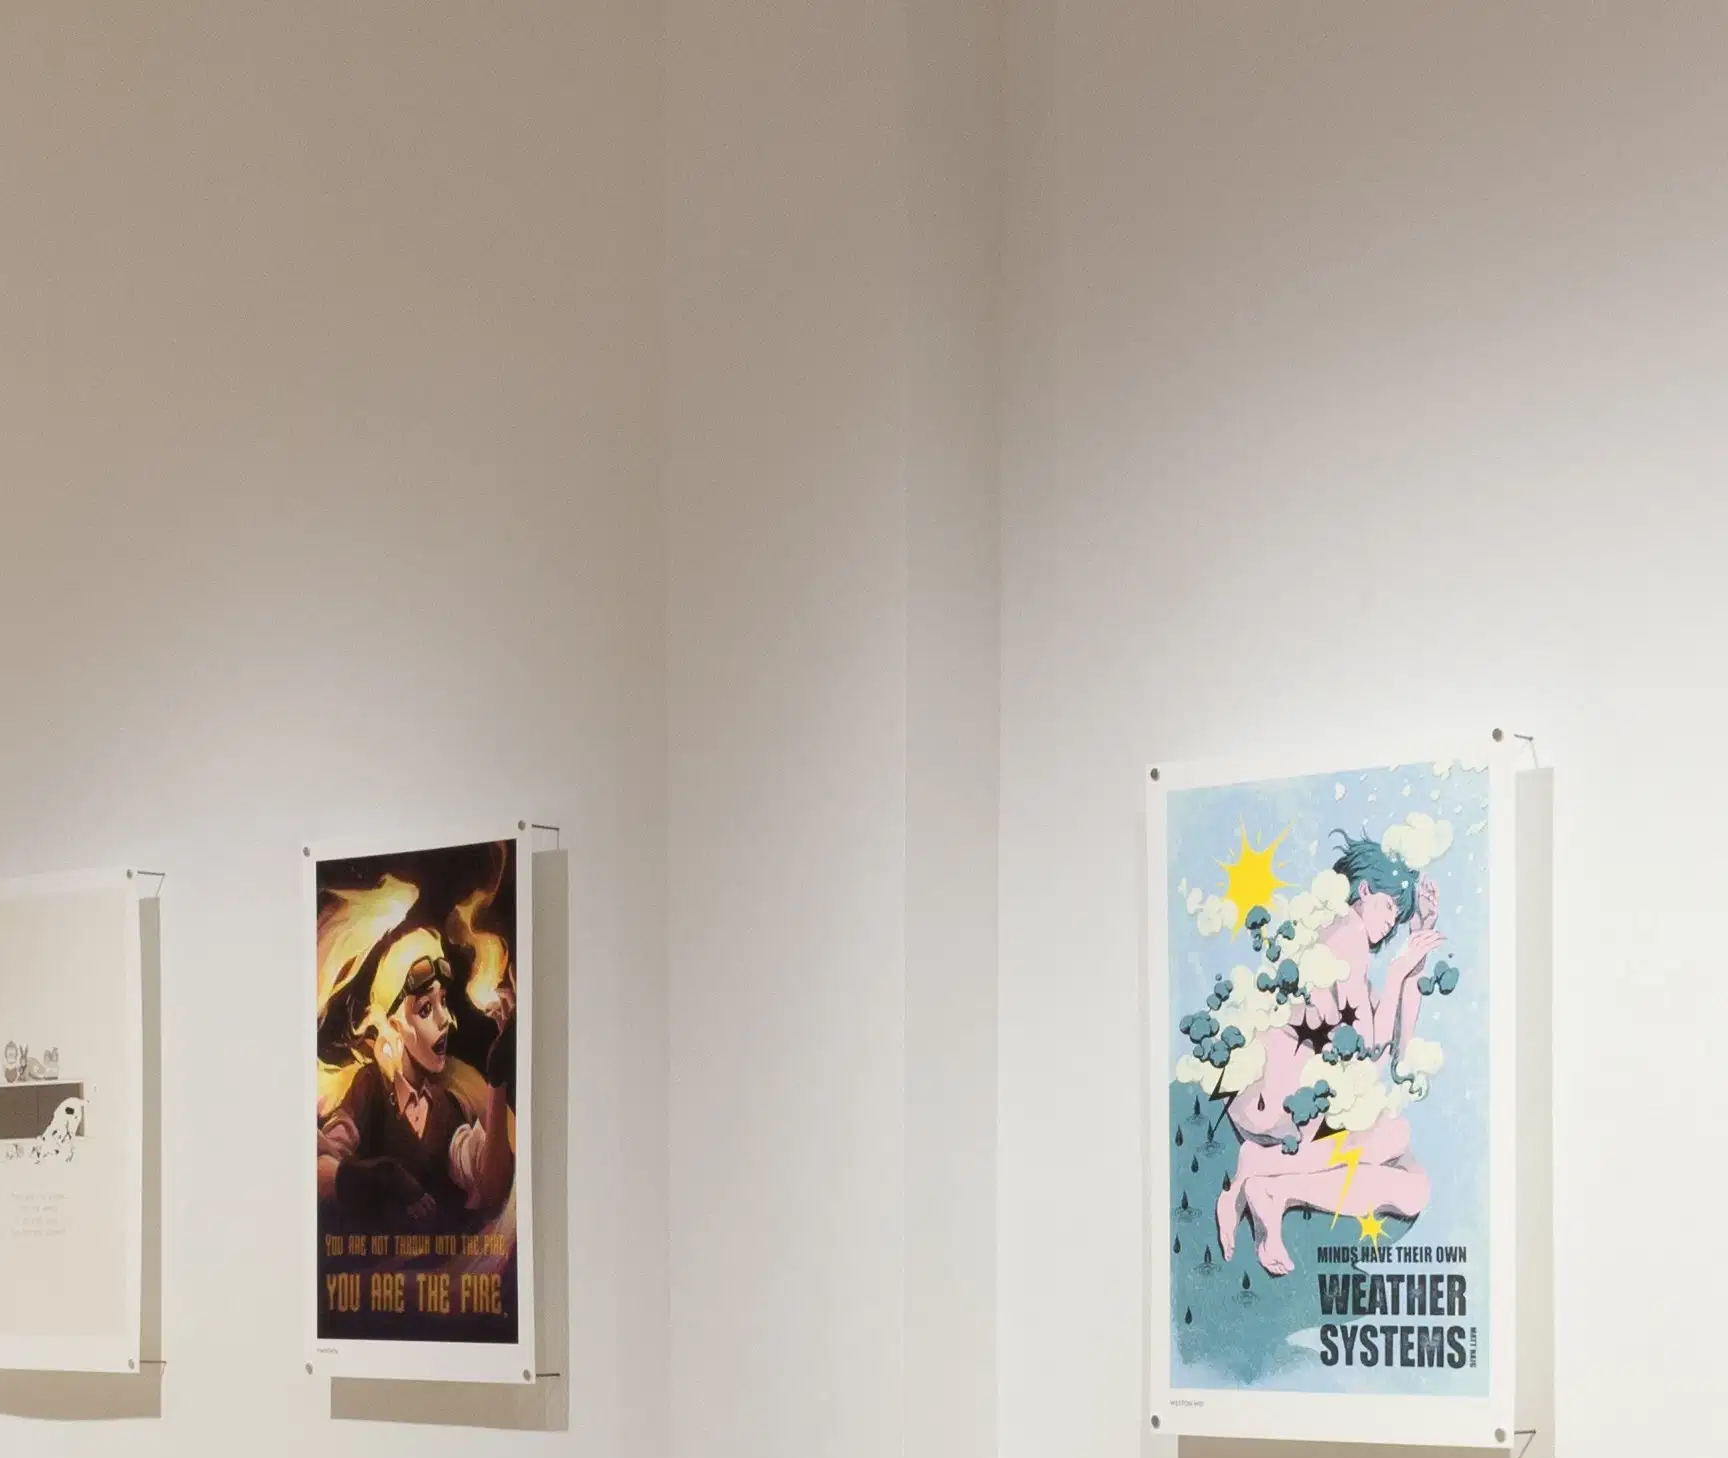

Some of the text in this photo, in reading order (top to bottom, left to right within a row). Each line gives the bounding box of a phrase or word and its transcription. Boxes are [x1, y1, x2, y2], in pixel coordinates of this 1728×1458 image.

[326, 1234, 344, 1256] YOU
[348, 1234, 367, 1256] ARE
[372, 1234, 389, 1256] NOT
[395, 1234, 430, 1257] THROWN
[435, 1235, 456, 1256] INTO
[461, 1235, 480, 1257] THE
[1317, 1246, 1467, 1263] MINDS HAVE THEIR OWN
[326, 1272, 361, 1312] YOU
[371, 1272, 405, 1314] ARE
[416, 1272, 450, 1314] THE
[1318, 1274, 1467, 1316] WEATHER
[1320, 1324, 1466, 1369] SYSTEMS
